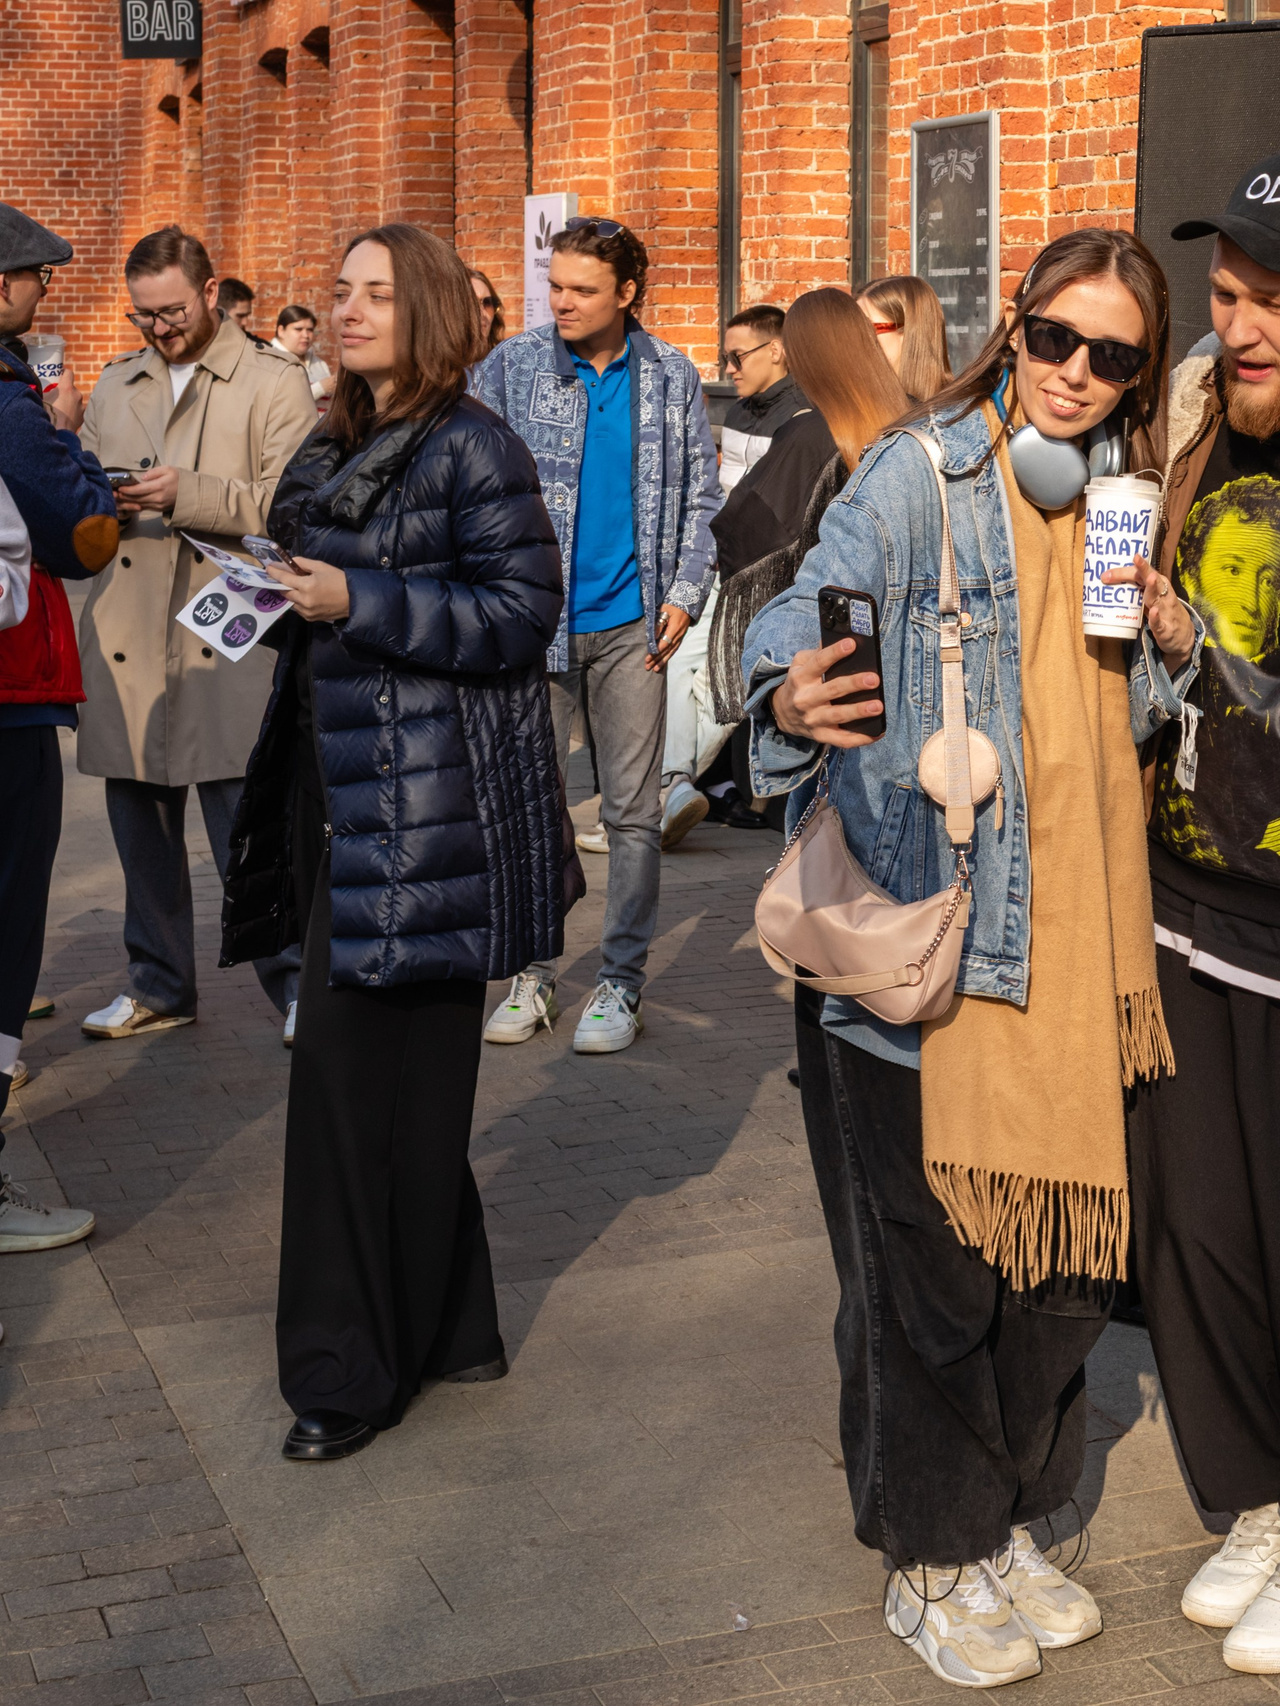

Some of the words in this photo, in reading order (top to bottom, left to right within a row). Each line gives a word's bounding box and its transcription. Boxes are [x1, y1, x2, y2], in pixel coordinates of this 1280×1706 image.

[126, 0, 195, 41] BAR
[1086, 508, 1152, 536] ДАВАЙ
[1085, 534, 1149, 559] ДЕЛАТЬ
[194, 607, 223, 624] ART
[224, 628, 252, 645] ART
